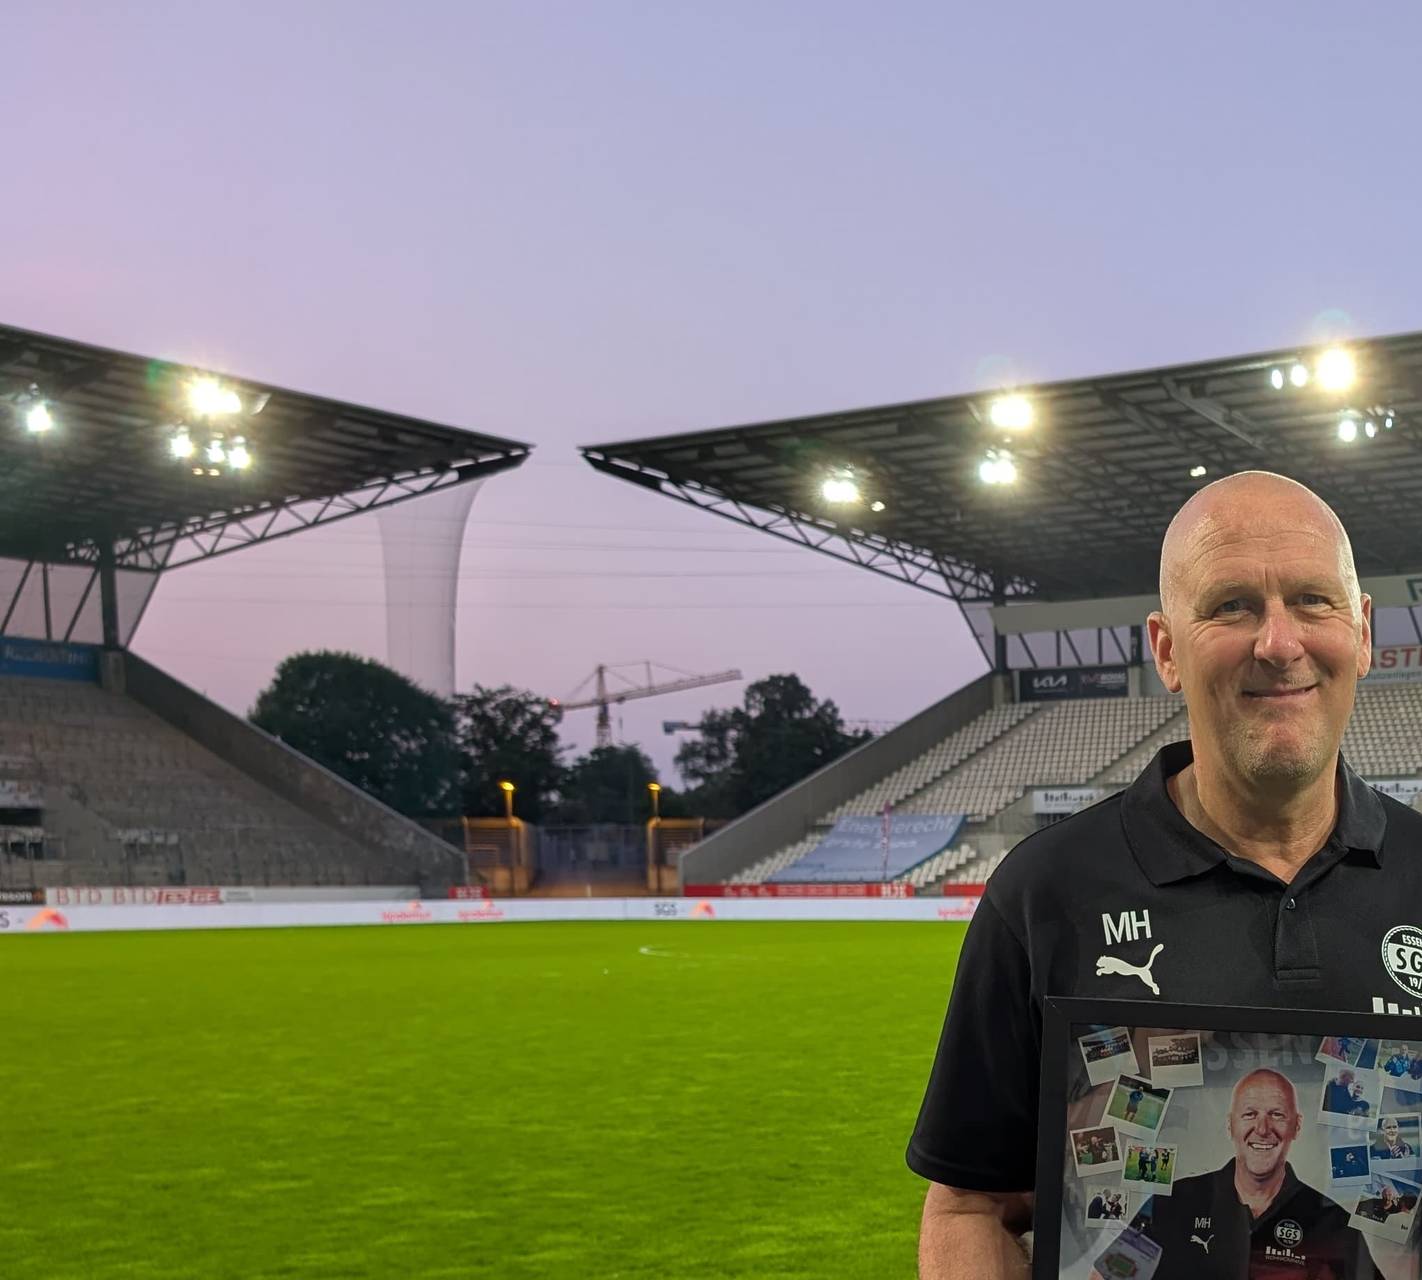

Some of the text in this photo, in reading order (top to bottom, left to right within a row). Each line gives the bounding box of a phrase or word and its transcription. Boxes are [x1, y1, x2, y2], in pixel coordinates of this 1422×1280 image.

[1101, 909, 1153, 946] MH
[1194, 1217, 1212, 1229] MH
[1279, 1227, 1299, 1241] SGS
